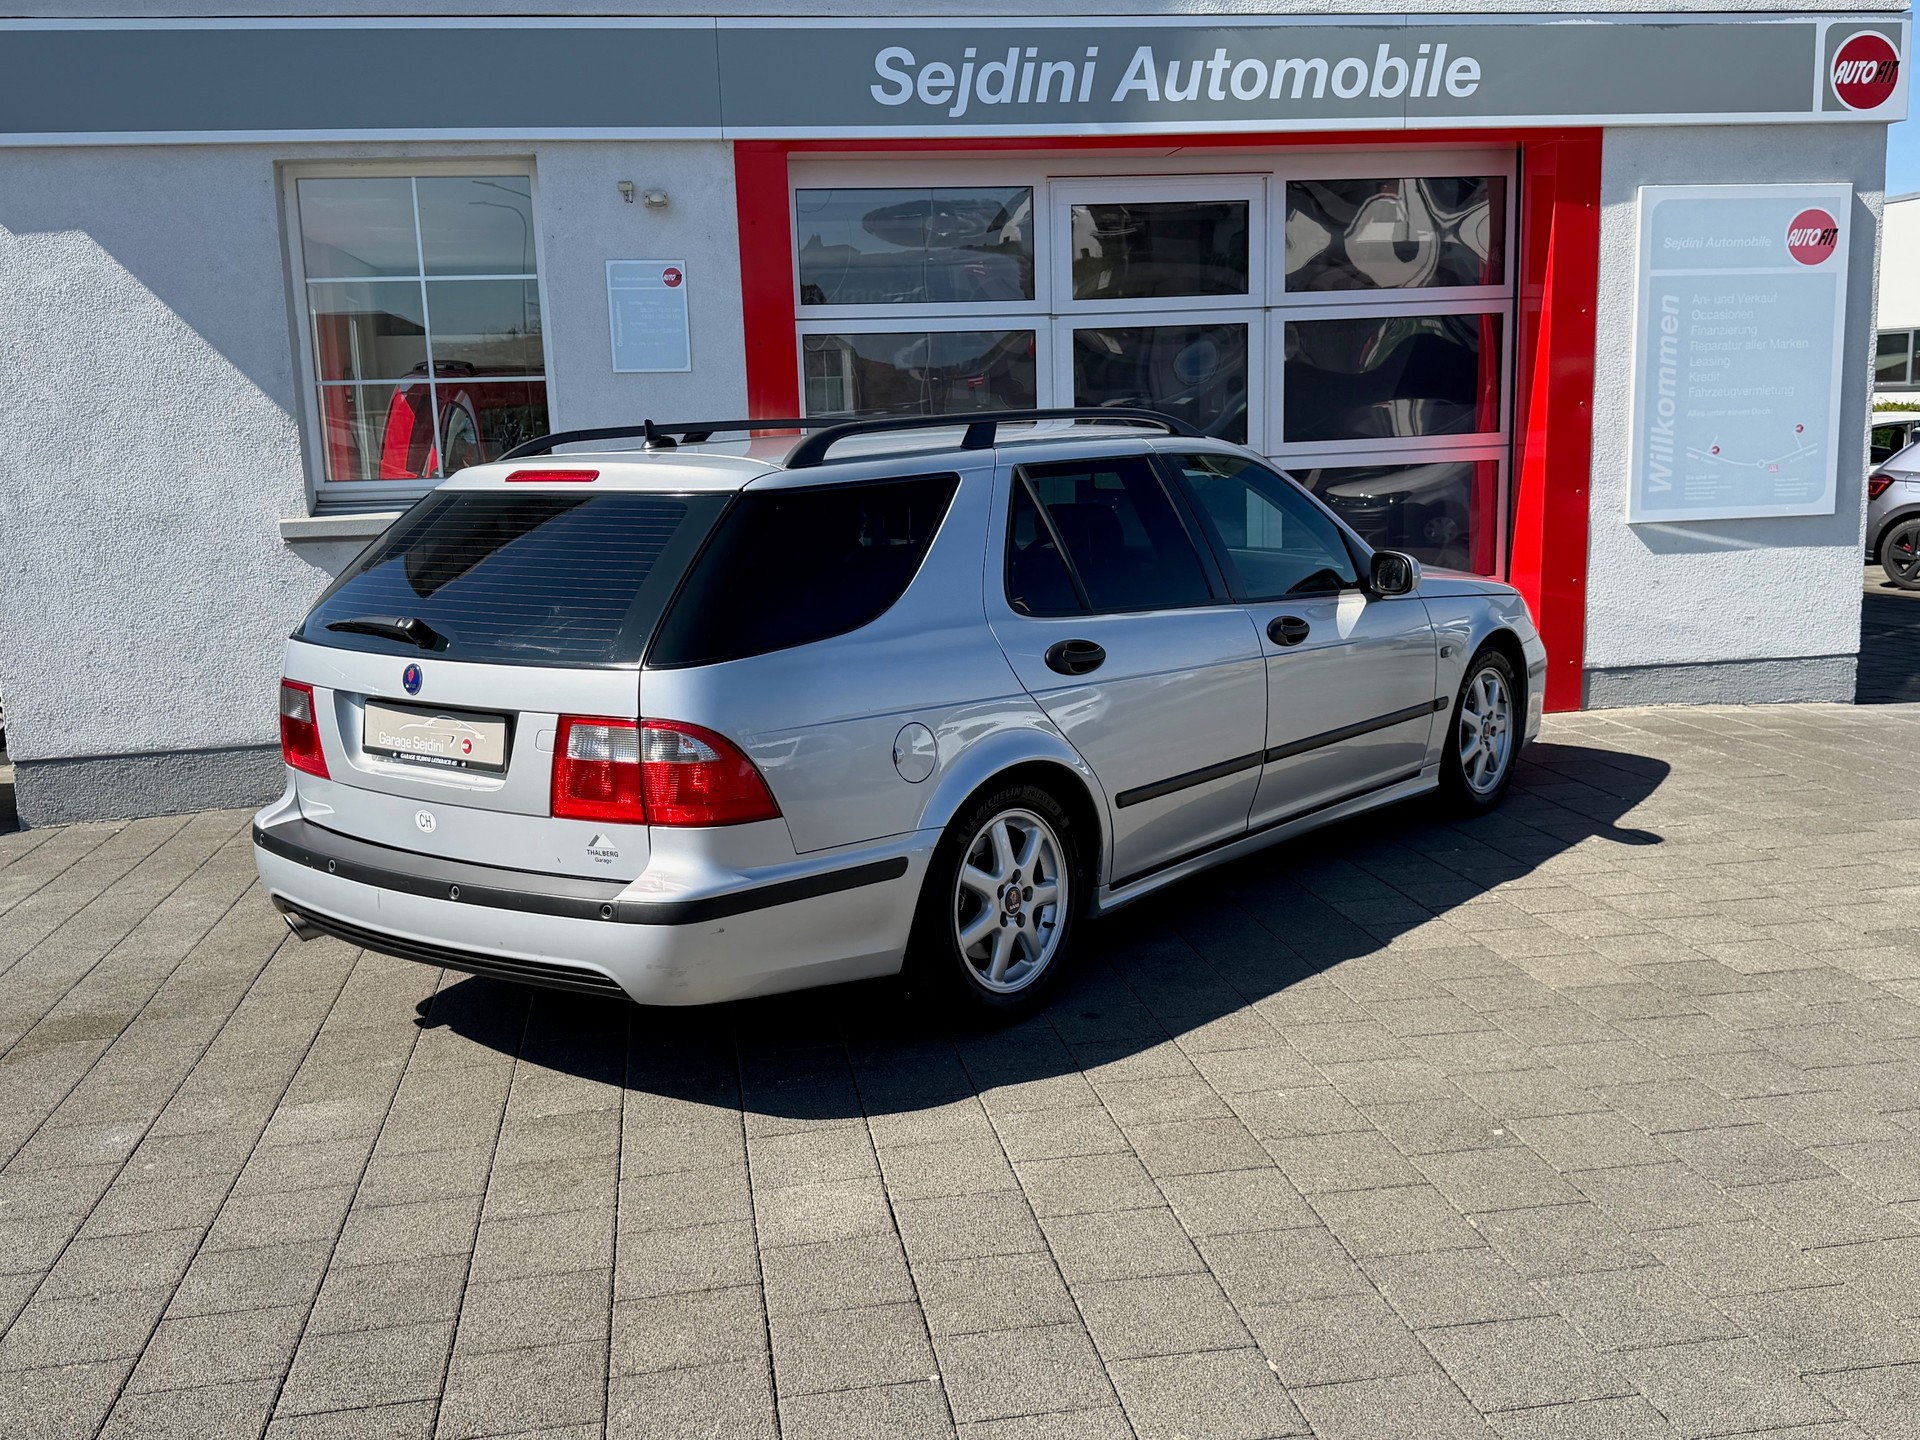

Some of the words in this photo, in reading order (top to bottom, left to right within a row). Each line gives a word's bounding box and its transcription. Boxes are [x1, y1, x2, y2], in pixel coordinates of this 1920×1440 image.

[1834, 60, 1900, 84] AUTOFIT
[870, 46, 1098, 117] Sejdini
[1110, 43, 1482, 103] Automobile
[1663, 236, 1704, 250] Sejdini
[1705, 236, 1772, 248] Automobile
[1787, 228, 1839, 247] AUTOFIT
[1714, 293, 1735, 304] und
[1737, 291, 1778, 304] Verkauf
[1691, 309, 1754, 321] Occasionen
[1690, 325, 1758, 337] Finanzierung
[1690, 340, 1742, 353] Reparatur
[1745, 340, 1767, 350] aller
[1770, 338, 1809, 349] Marken
[1689, 356, 1731, 368] Leasing
[1688, 371, 1720, 382] Kredit
[1648, 294, 1680, 493] Willkommen
[1688, 385, 1795, 399] Fahrzeugvermietung
[378, 731, 412, 750] Garage
[412, 735, 444, 753] Sejdini
[977, 787, 1022, 819] MICHELIN
[419, 814, 432, 828] CH
[586, 849, 619, 857] THALBERG
